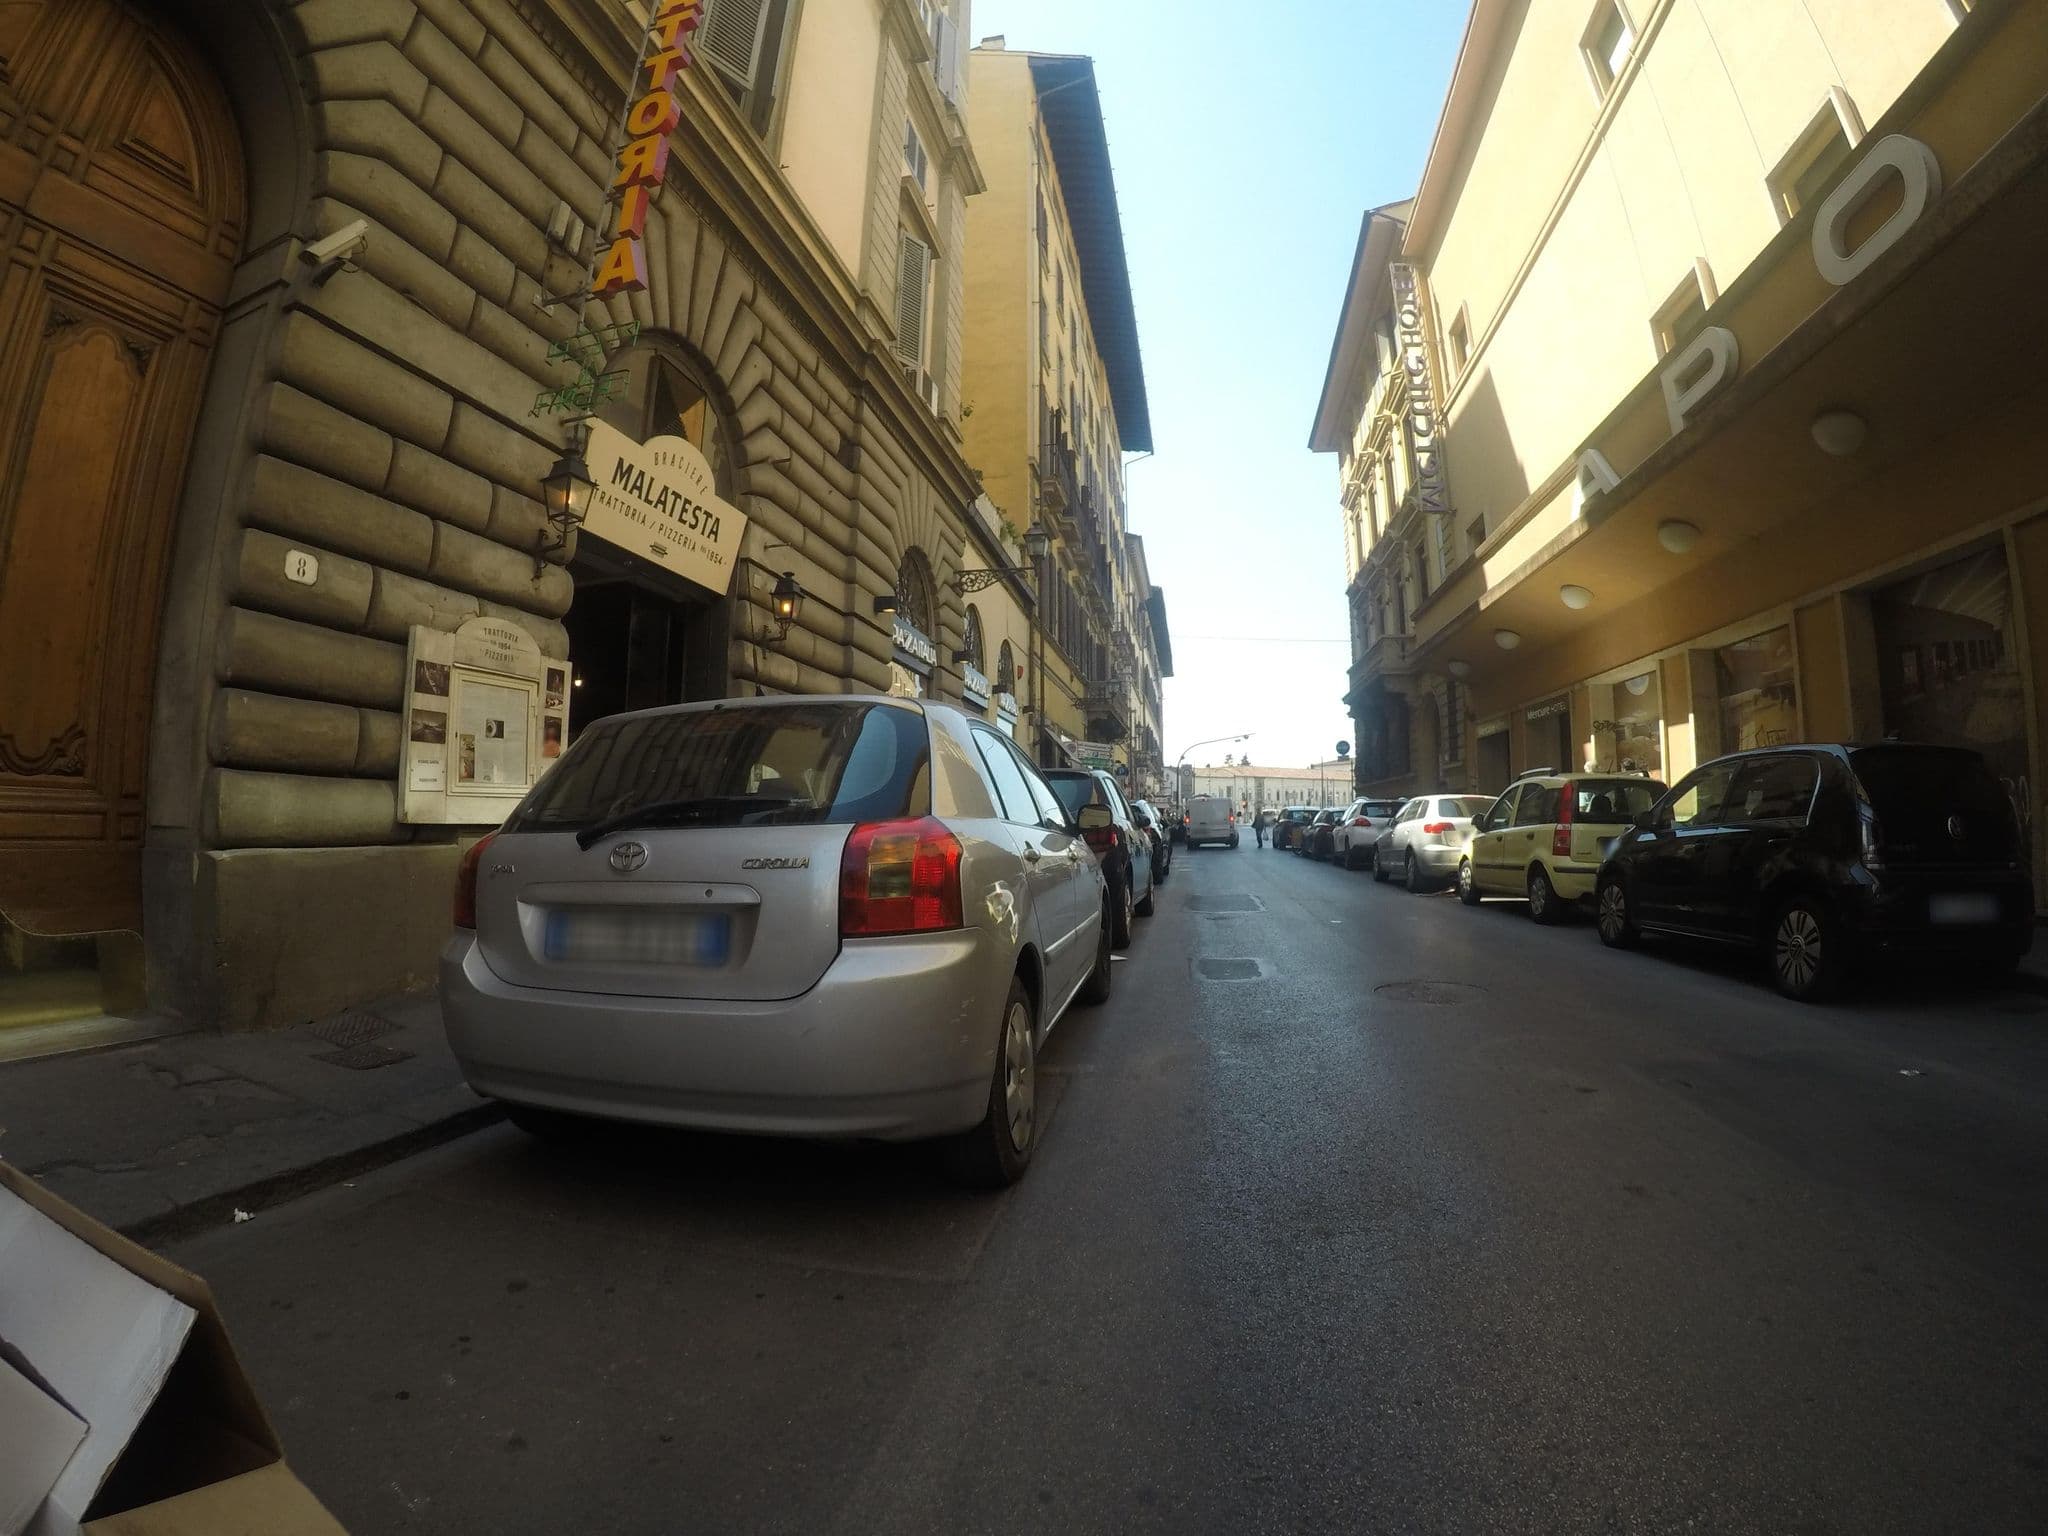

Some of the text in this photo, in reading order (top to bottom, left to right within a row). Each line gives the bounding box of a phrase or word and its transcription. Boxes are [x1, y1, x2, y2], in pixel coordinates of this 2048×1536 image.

[654, 451, 708, 496] BRACIERE
[594, 487, 647, 527] TRATTORIA
[658, 522, 696, 552] PIZZERIA
[611, 456, 721, 543] MALATESTA
[297, 557, 306, 578] 8
[741, 857, 810, 870] COROLLA
